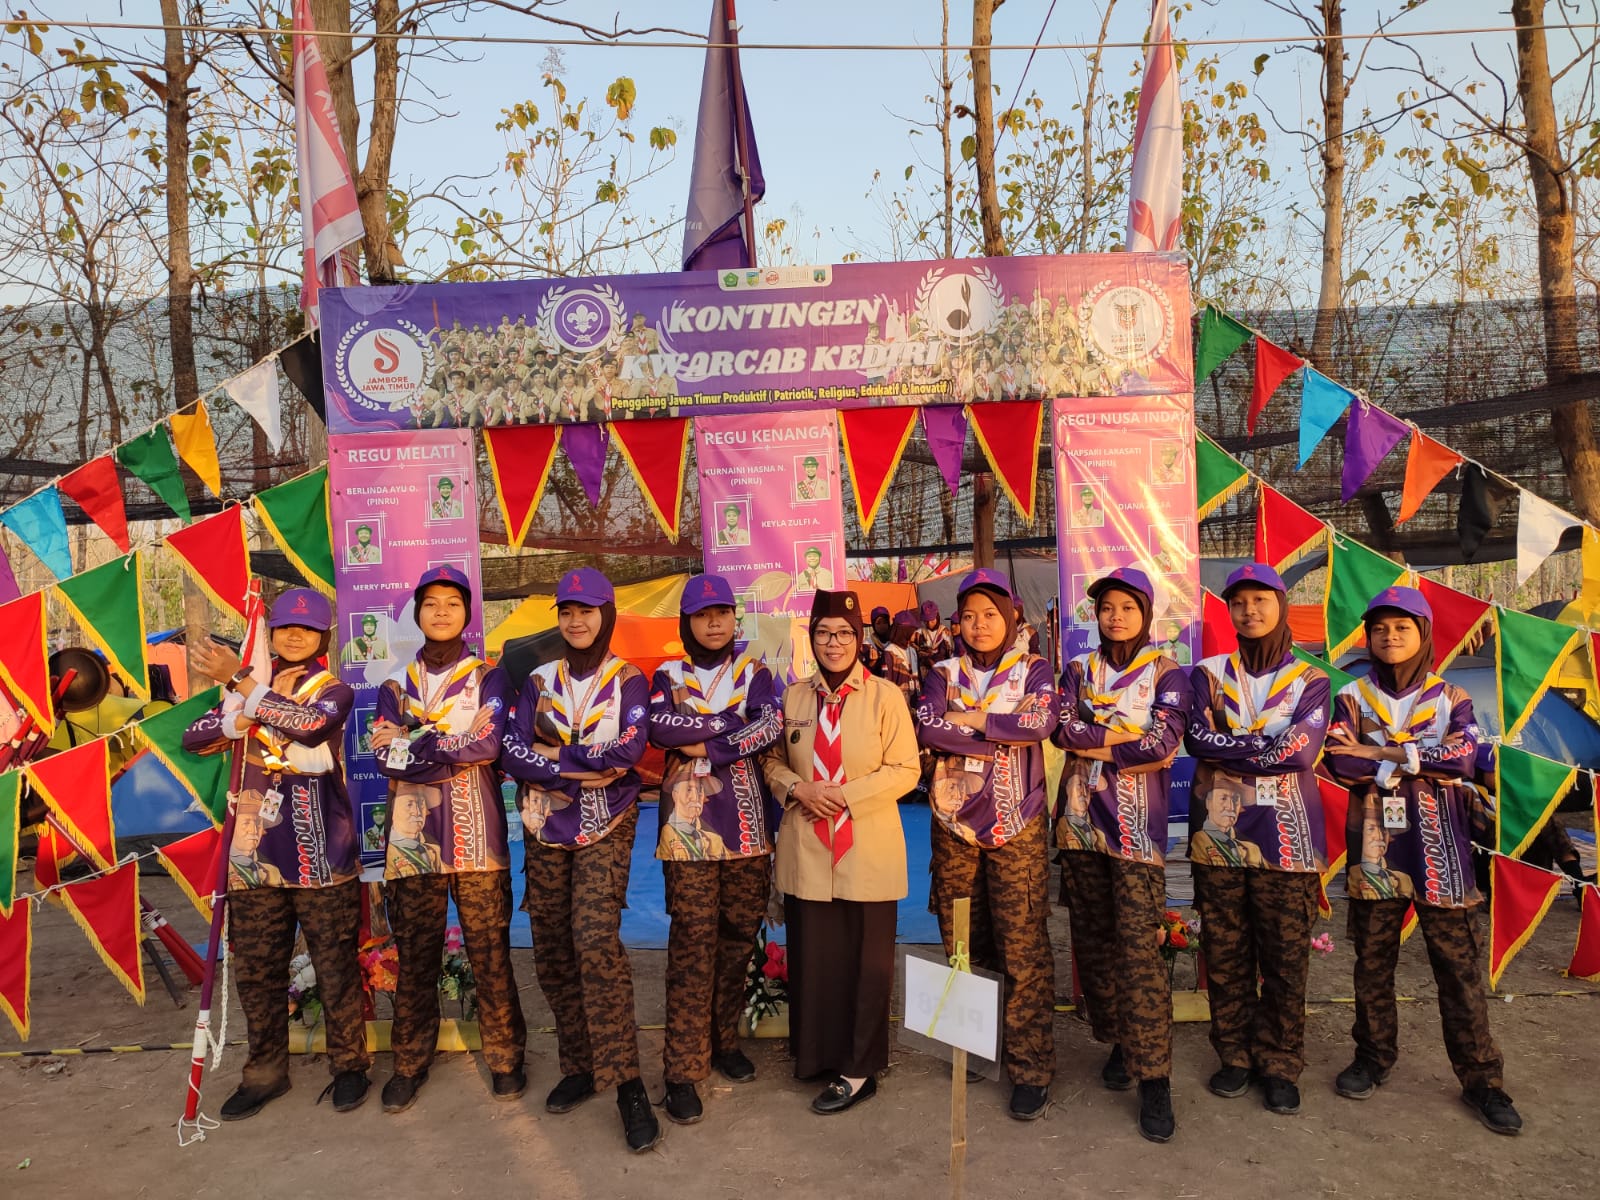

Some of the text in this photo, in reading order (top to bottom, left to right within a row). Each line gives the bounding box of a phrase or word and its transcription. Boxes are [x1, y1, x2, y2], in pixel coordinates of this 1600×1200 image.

[669, 299, 883, 333] KONTINGEN
[619, 340, 941, 380] KWARCAB KEDIRI
[367, 376, 409, 384] JAMBORE
[361, 384, 386, 392] JAWA
[611, 397, 668, 412] Penggalang
[668, 394, 694, 407] Jawa
[694, 392, 721, 405] Timur
[723, 390, 768, 404] Produktif
[774, 389, 817, 401] Patriotik,
[818, 386, 859, 400] Religius,
[860, 382, 900, 396] Edukatif
[901, 383, 909, 394] &
[1059, 413, 1096, 426] REGU
[1100, 412, 1140, 425] NUSA
[704, 426, 832, 445] REGU KENANGA
[348, 444, 456, 463] REGU MELATI
[730, 477, 762, 487] (PINRU)
[346, 486, 389, 496] BERLINDA
[390, 485, 407, 494] AYU
[367, 497, 399, 507] (PINRU)
[761, 519, 787, 528] KEYLA
[388, 539, 430, 548] FATIMATUL
[380, 582, 403, 590] PUTRI
[353, 772, 375, 781] REVA
[292, 785, 319, 887] #PRODUKTIF
[1418, 791, 1451, 905] #PRODUKTIF
